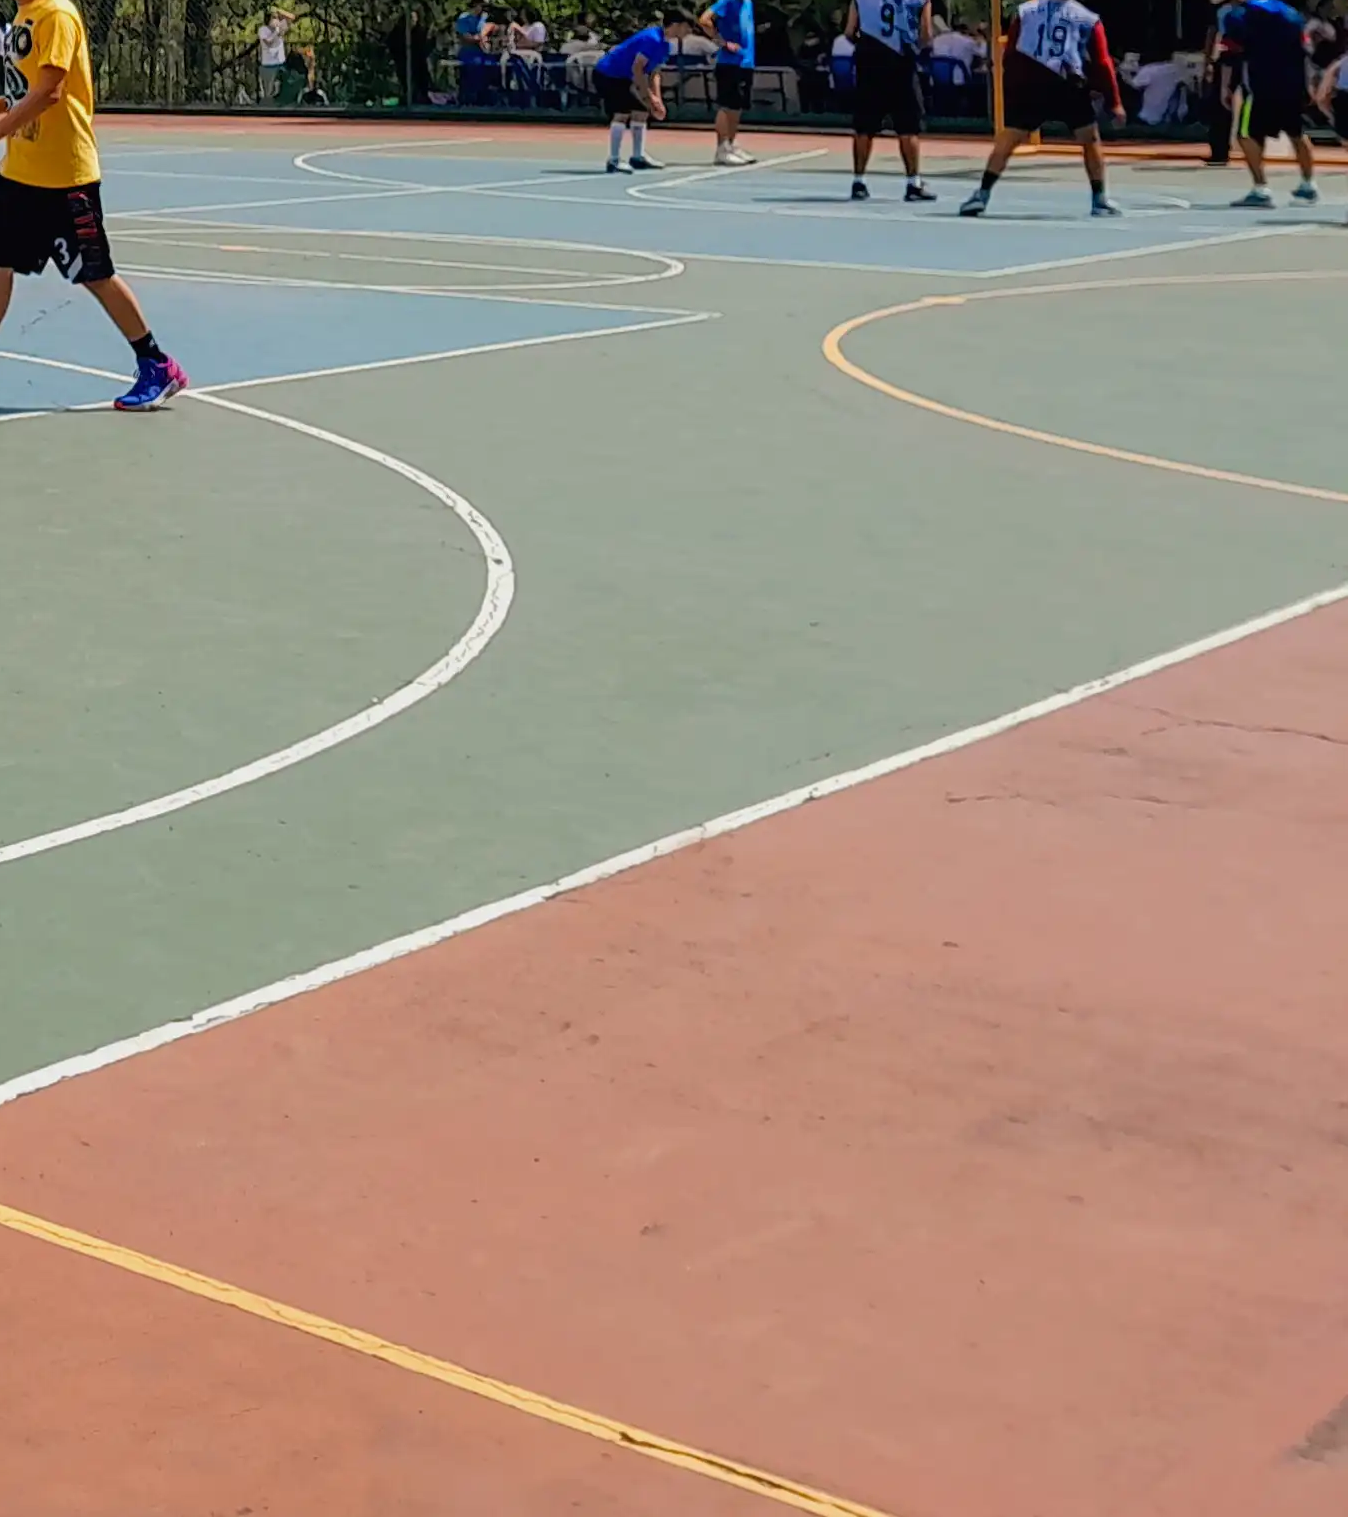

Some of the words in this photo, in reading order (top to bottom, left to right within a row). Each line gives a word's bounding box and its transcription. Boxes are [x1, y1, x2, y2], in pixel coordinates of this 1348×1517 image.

[880, 2, 895, 38] 9
[1034, 23, 1067, 58] 19
[53, 236, 71, 265] 3
